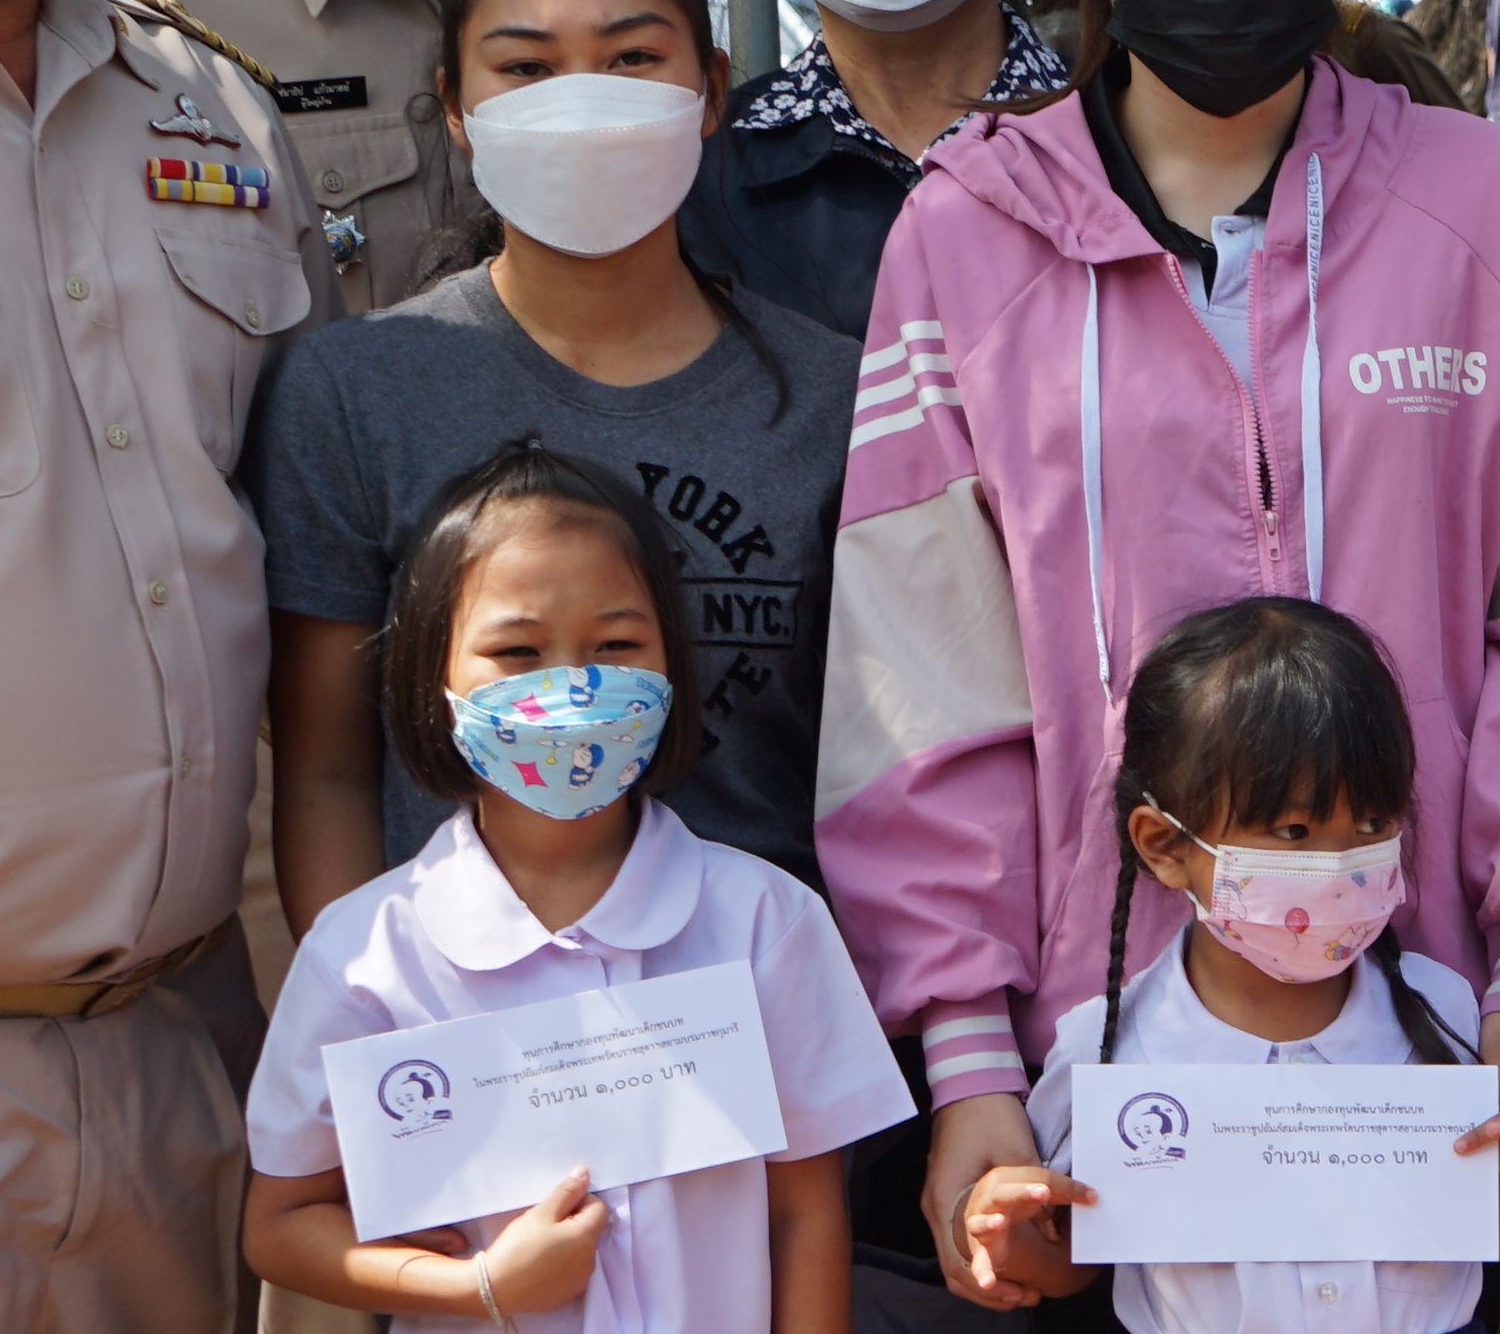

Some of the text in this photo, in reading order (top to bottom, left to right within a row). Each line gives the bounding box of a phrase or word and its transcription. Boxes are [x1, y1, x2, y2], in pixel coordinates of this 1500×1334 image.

[1349, 344, 1488, 396] OTHERS
[528, 1058, 698, 1109] จำนวน ๑,๐๐๐ บาท
[1262, 1145, 1428, 1167] จำนวน ๑,๐๐๐ บาท
